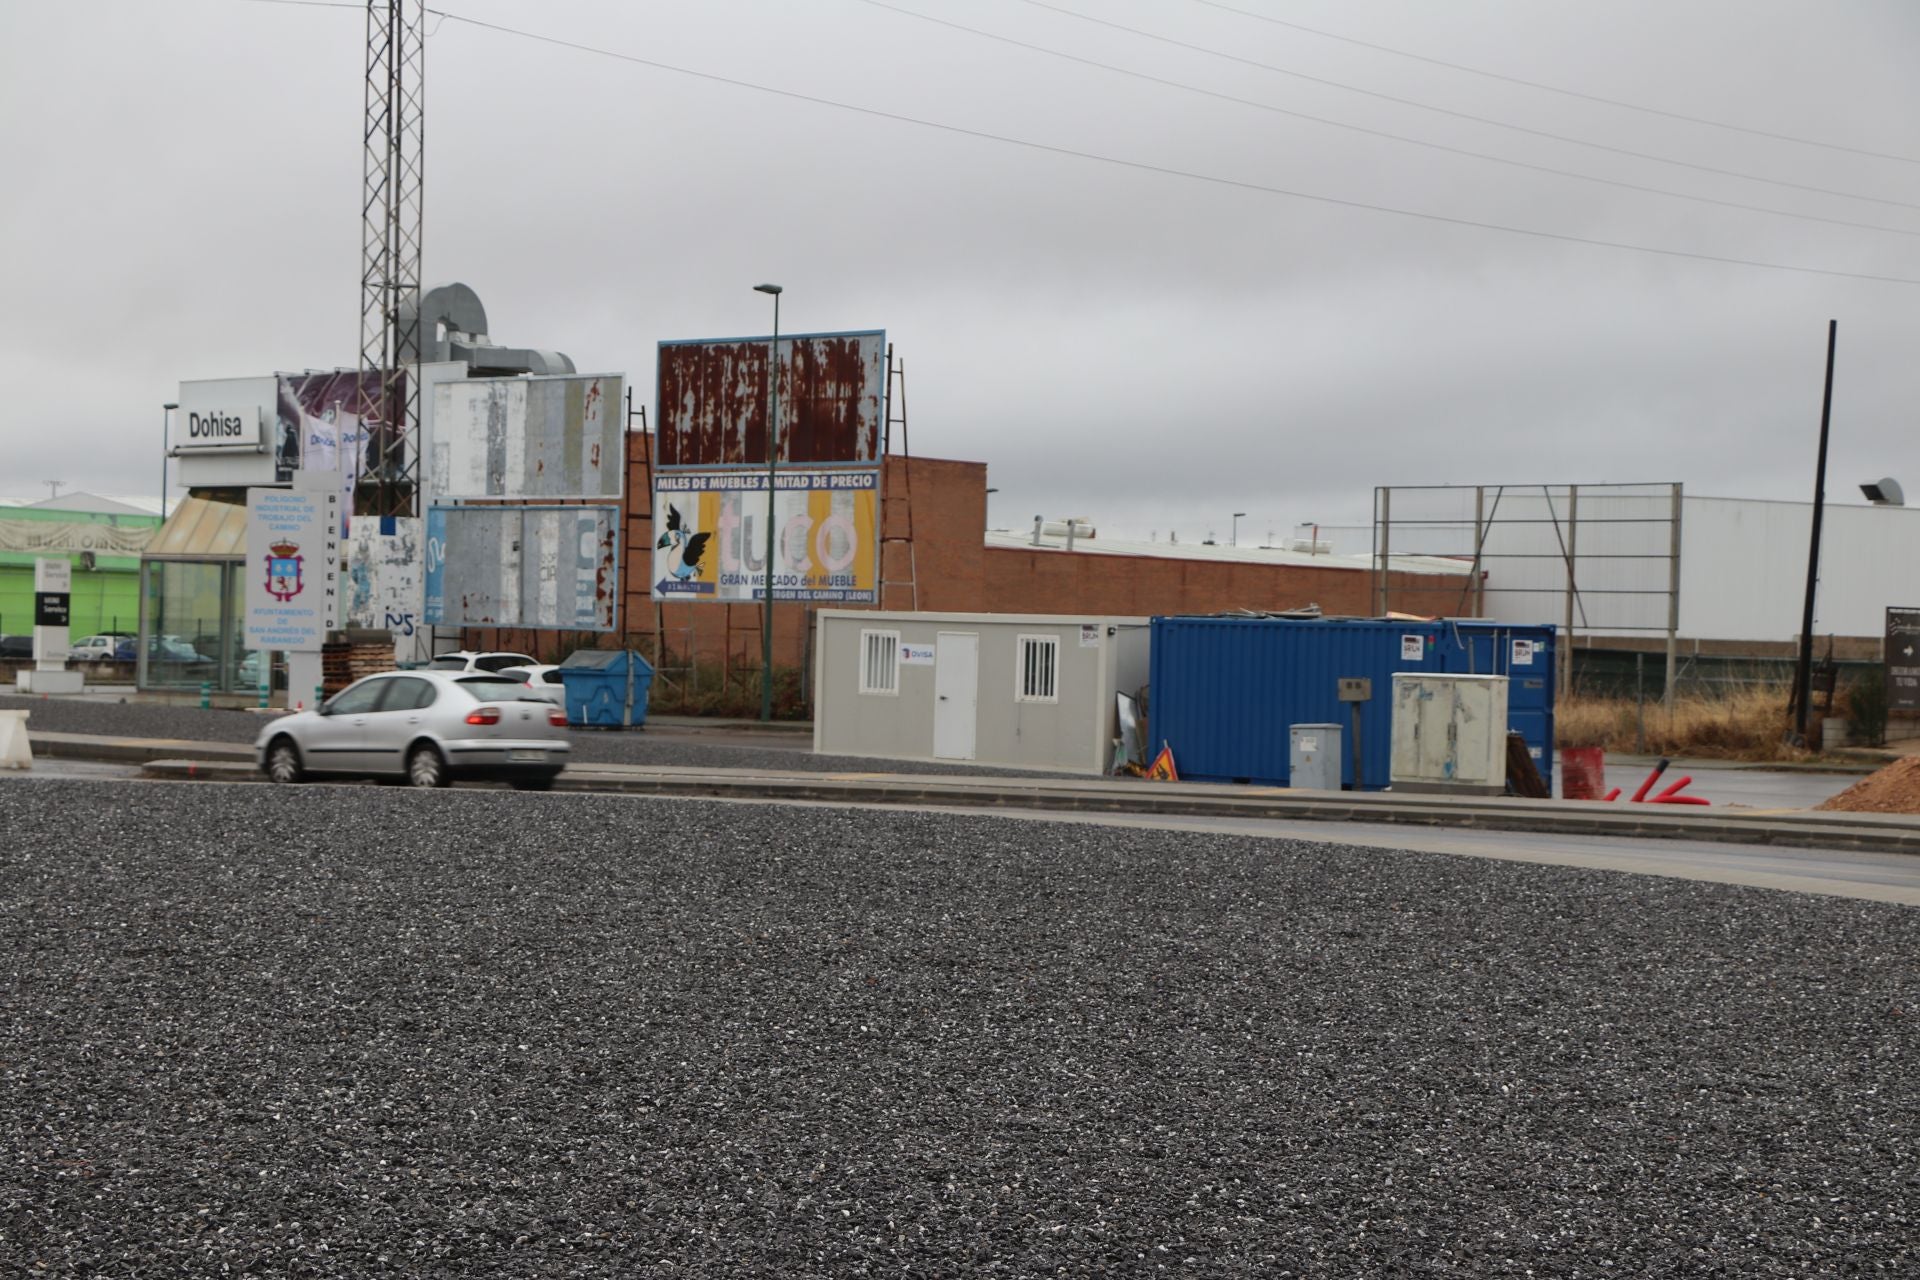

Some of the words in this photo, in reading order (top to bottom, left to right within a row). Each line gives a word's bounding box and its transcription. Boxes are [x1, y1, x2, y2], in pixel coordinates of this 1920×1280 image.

[189, 411, 242, 438] Dohisa
[657, 477, 690, 489] MILES
[692, 477, 705, 489] DE
[709, 476, 758, 489] MUEBLES
[761, 476, 770, 488] A
[774, 475, 809, 488] MITAD
[812, 475, 827, 488] DE
[831, 474, 872, 487] PRECIO
[304, 505, 315, 513] DE
[297, 514, 312, 522] DEL
[718, 503, 858, 573] tuco
[326, 495, 336, 628] BIENVENID
[720, 574, 749, 586] GRAN
[751, 574, 798, 586] MECADO
[801, 575, 816, 586] del
[818, 575, 857, 586] MUEBLE
[757, 590, 767, 598] LA
[769, 590, 796, 599] IRGEN
[798, 590, 812, 599] DEL
[813, 590, 843, 600] CAMINO
[44, 605, 67, 613] Service
[254, 608, 314, 616] AYUNTAMIENTO
[301, 627, 316, 635] DEL
